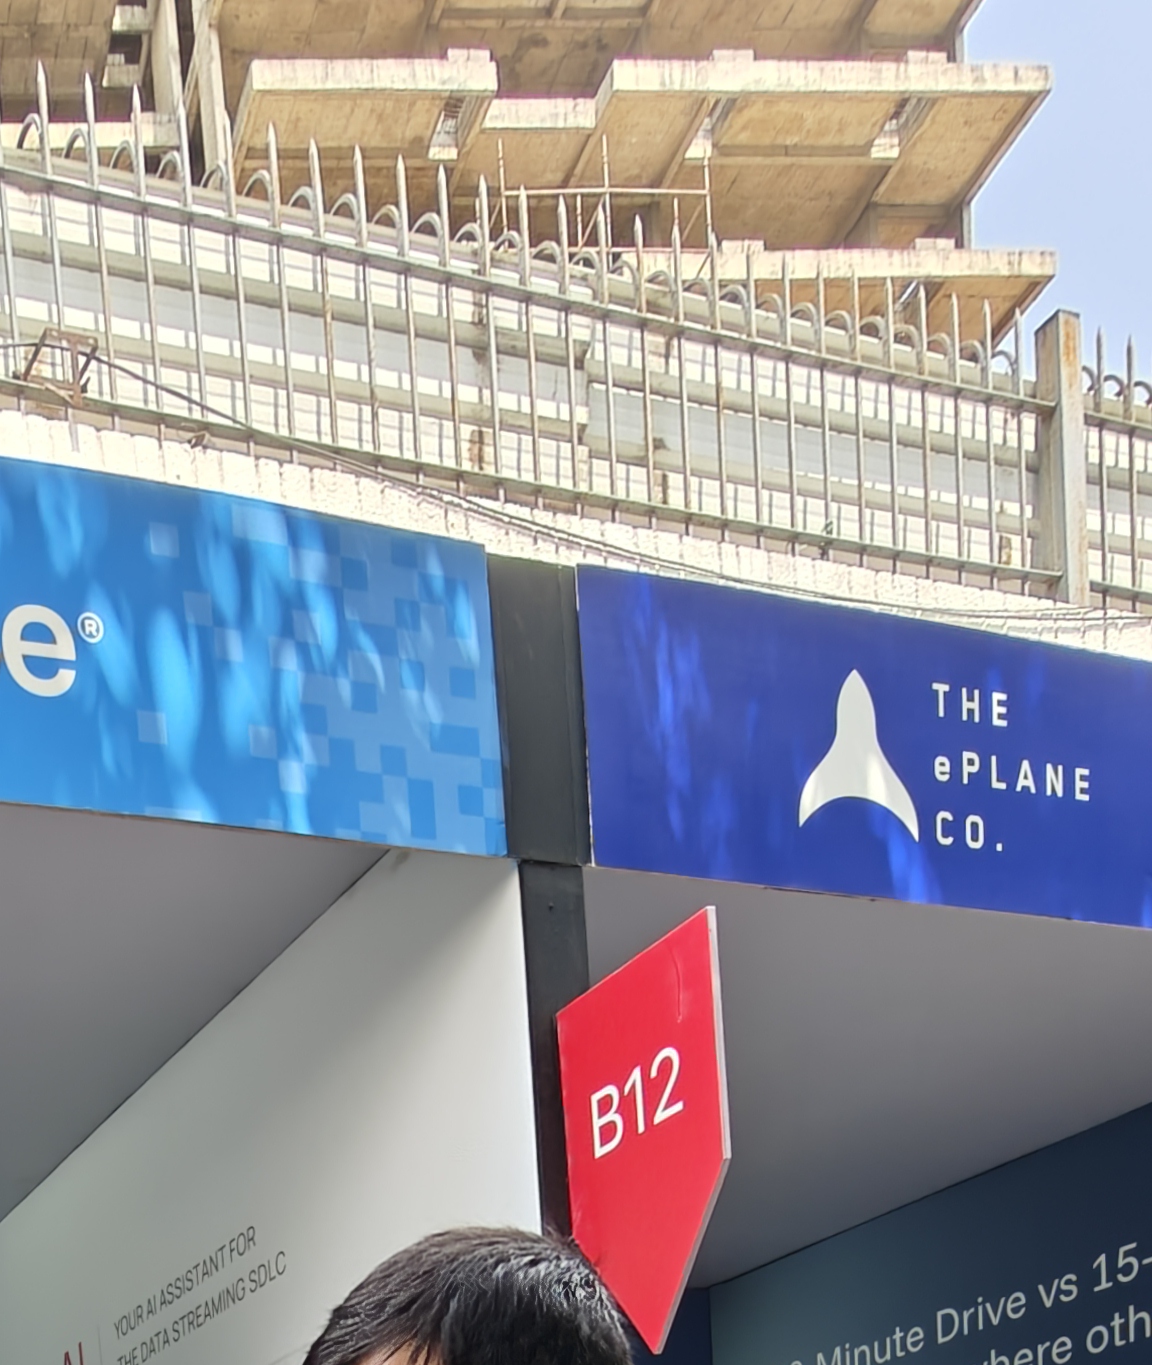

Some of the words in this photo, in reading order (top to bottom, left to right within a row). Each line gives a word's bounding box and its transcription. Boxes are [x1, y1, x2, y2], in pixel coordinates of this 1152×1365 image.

[931, 681, 1009, 728] THE
[933, 750, 1091, 802] ePLANE
[935, 809, 1004, 852] CO.
[590, 1046, 684, 1160] B12
[113, 1304, 145, 1340] YOUR
[146, 1294, 158, 1320] AI
[159, 1243, 227, 1312] ASSISTANT
[229, 1225, 257, 1264] FOR
[140, 1327, 171, 1364] DATA
[172, 1277, 246, 1344] STREAMING
[248, 1250, 287, 1294] SDLC
[935, 1290, 1027, 1345] Drive
[1036, 1272, 1078, 1309] vs
[1092, 1241, 1152, 1293] 15-
[1085, 1304, 1152, 1355] oth
